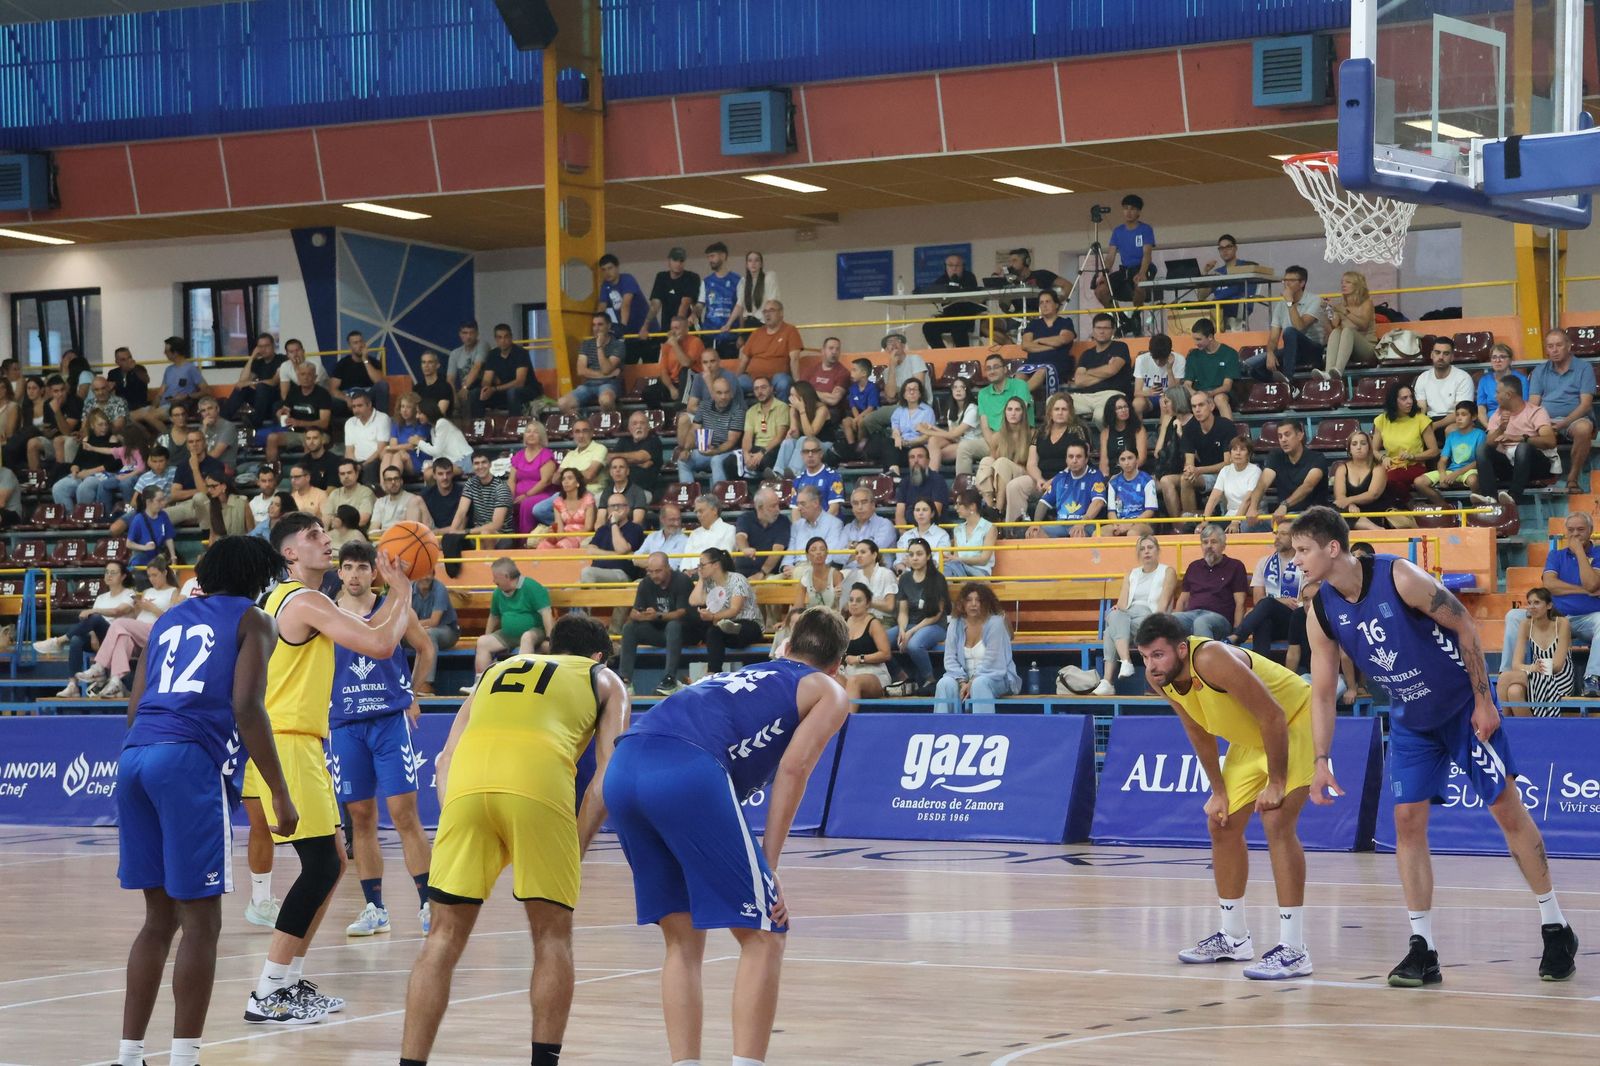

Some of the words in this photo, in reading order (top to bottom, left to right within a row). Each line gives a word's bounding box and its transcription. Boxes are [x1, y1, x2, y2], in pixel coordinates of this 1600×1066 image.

[1375, 379, 1387, 389] 17
[1357, 617, 1387, 645] 16
[158, 623, 216, 694] 12
[490, 658, 559, 695] 21
[342, 685, 360, 694] CAJA
[361, 683, 387, 691] RURAL
[92, 761, 119, 777] INN
[900, 733, 1010, 790] gaza
[3, 761, 57, 779] INNOVA
[0, 783, 28, 798] Chef
[87, 782, 117, 797] Chef
[892, 796, 947, 809] Ganaderos
[949, 798, 962, 810] de
[965, 799, 1005, 811] Zamora
[1559, 801, 1588, 813] Vivir
[917, 812, 946, 821] DESDE
[949, 813, 970, 821] 1966
